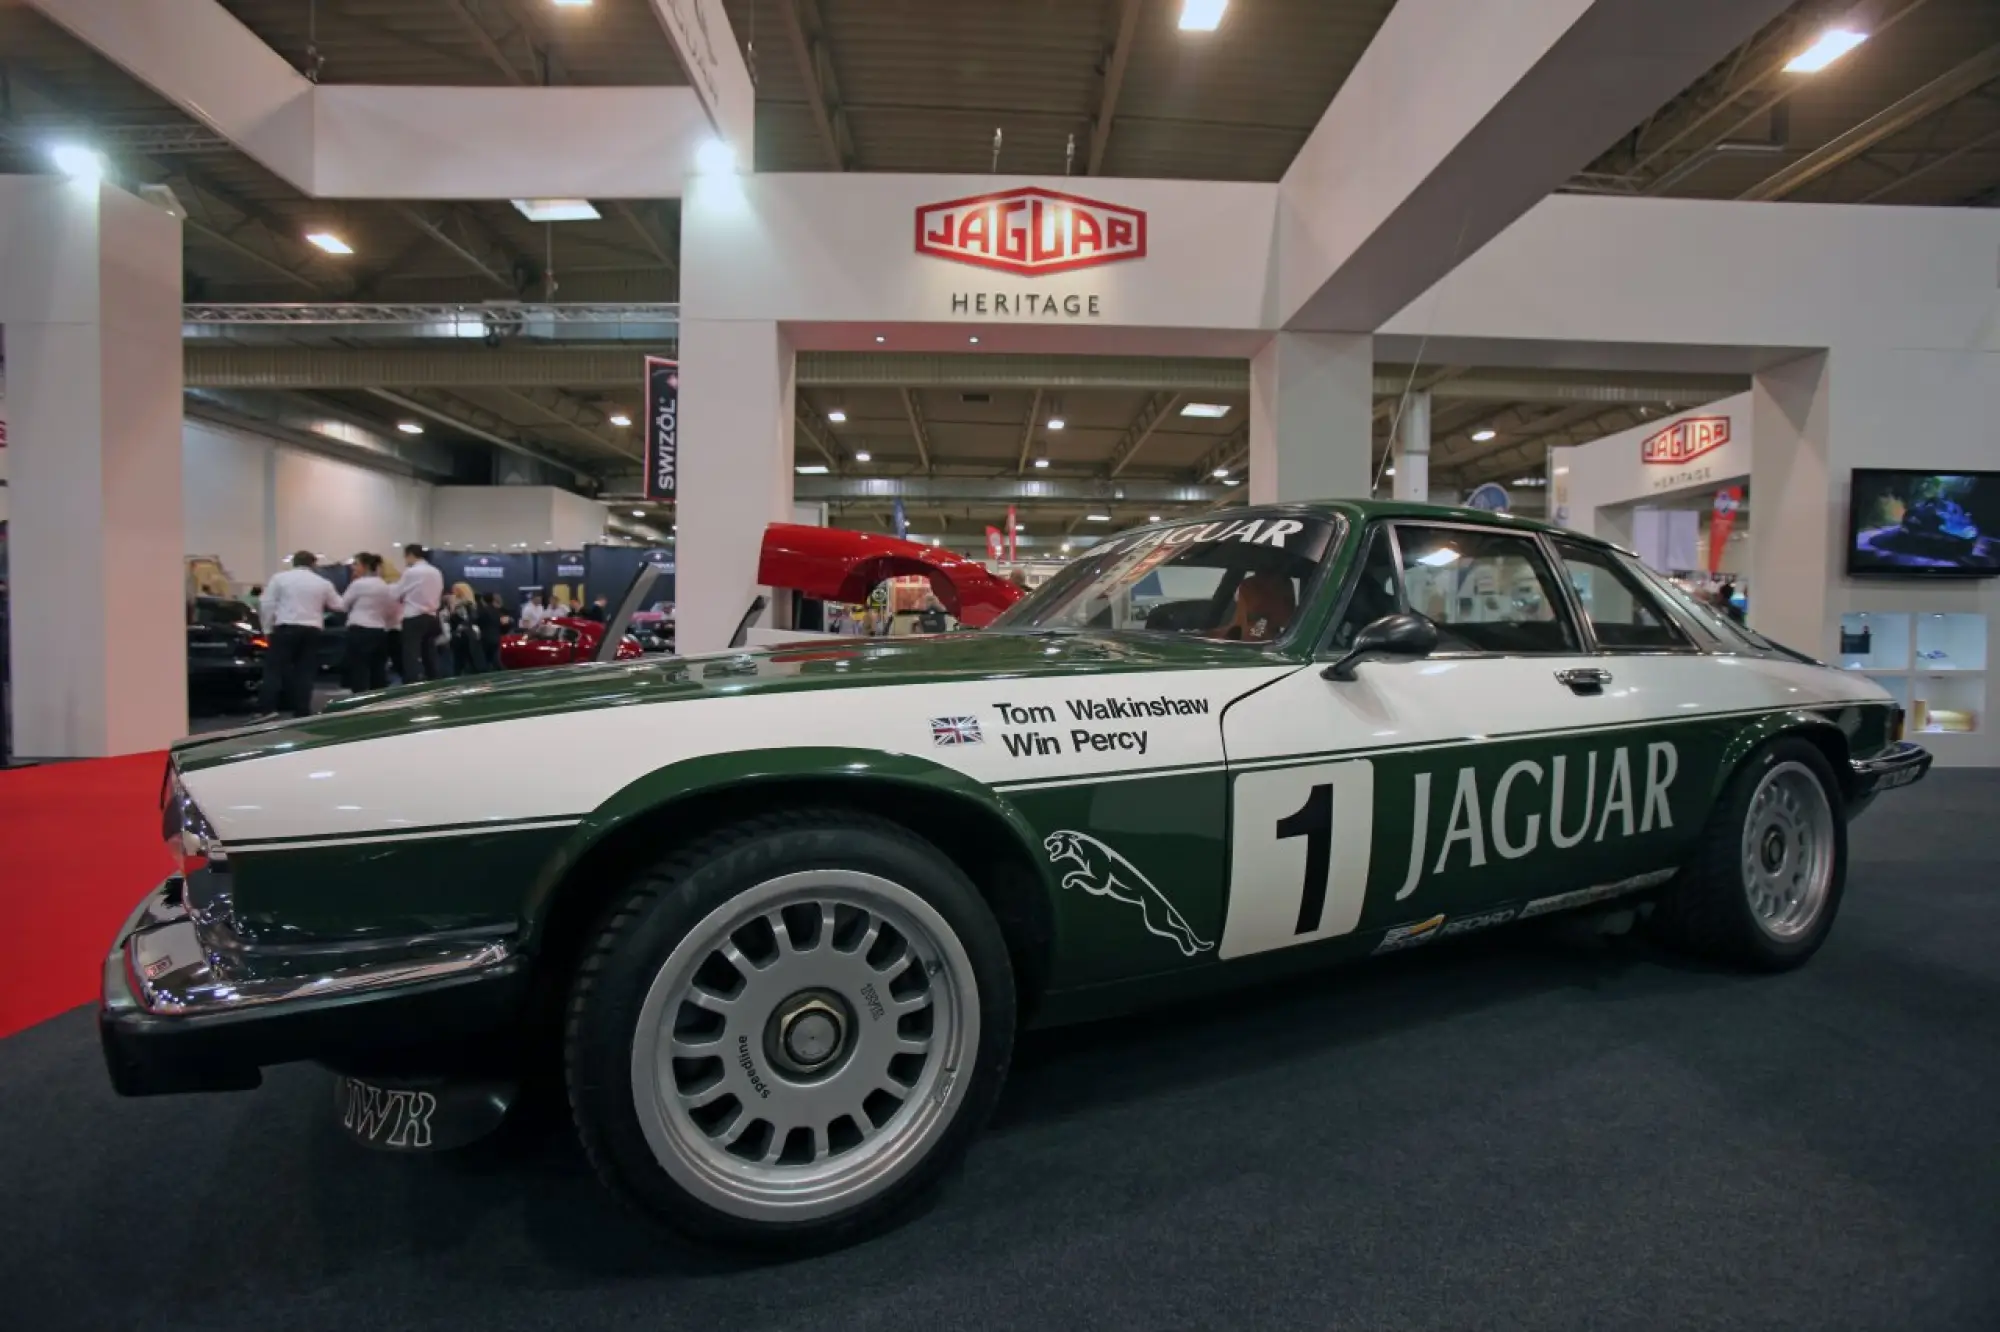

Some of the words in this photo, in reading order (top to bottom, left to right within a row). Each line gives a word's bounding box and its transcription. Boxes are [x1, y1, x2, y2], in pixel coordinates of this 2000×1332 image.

[926, 199, 1134, 263] JAGUAR
[951, 293, 1100, 317] HERITAGE
[1645, 422, 1724, 457] JAGUAR
[992, 701, 1056, 725] Tom
[1065, 695, 1209, 721] Walkinshaw
[1002, 731, 1061, 758] Win
[1070, 729, 1148, 755] Percy
[1394, 740, 1679, 901] JAGUAR
[1276, 783, 1334, 936] 1
[738, 1034, 772, 1100] speedline
